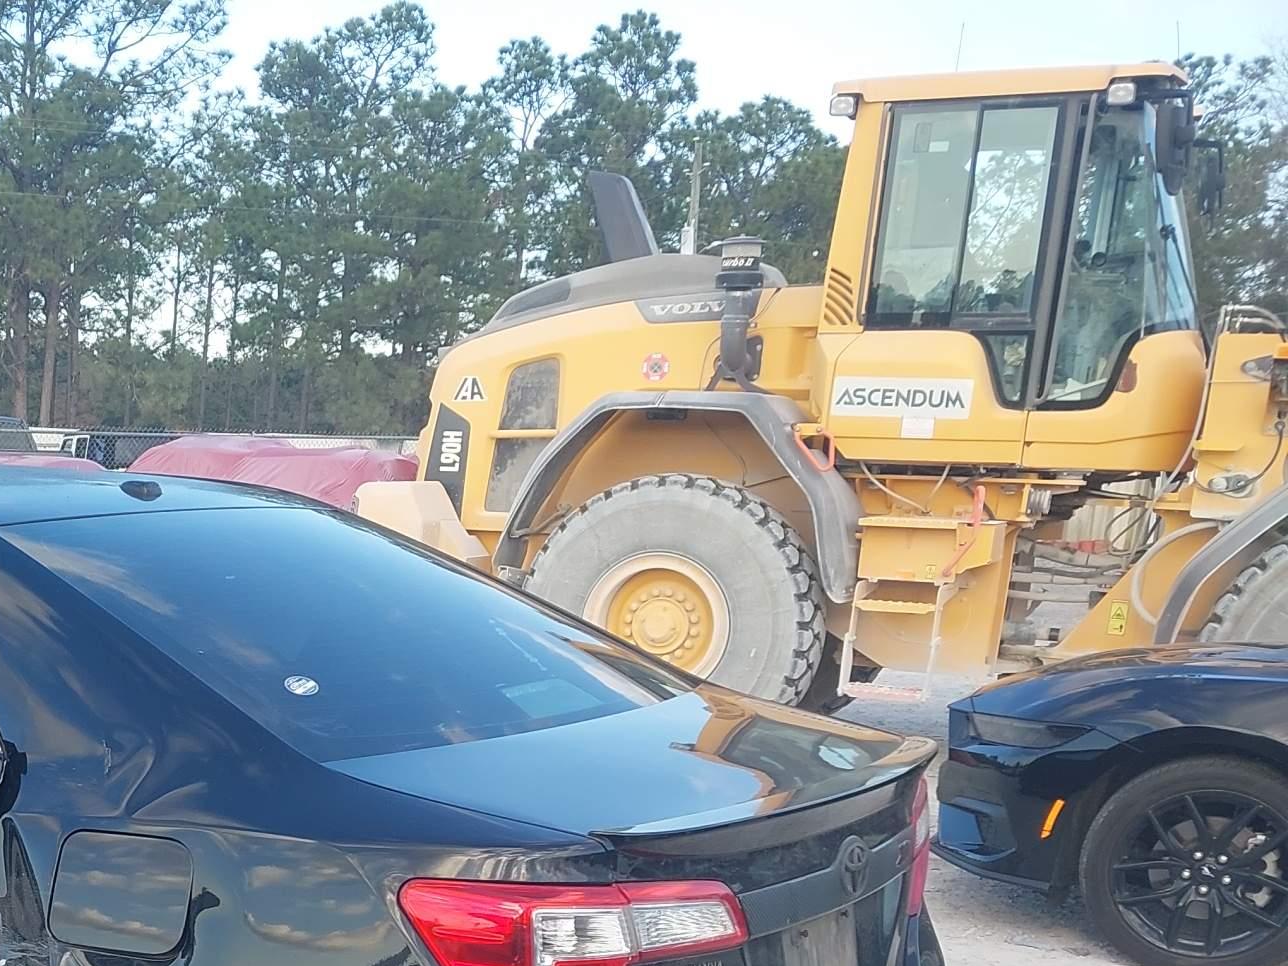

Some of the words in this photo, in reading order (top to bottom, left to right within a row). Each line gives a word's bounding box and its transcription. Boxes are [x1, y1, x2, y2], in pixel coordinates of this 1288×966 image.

[722, 257, 745, 267] urbo
[650, 300, 726, 316] VOLV
[835, 387, 966, 409] ASCENDUM
[439, 430, 463, 472] L90H
